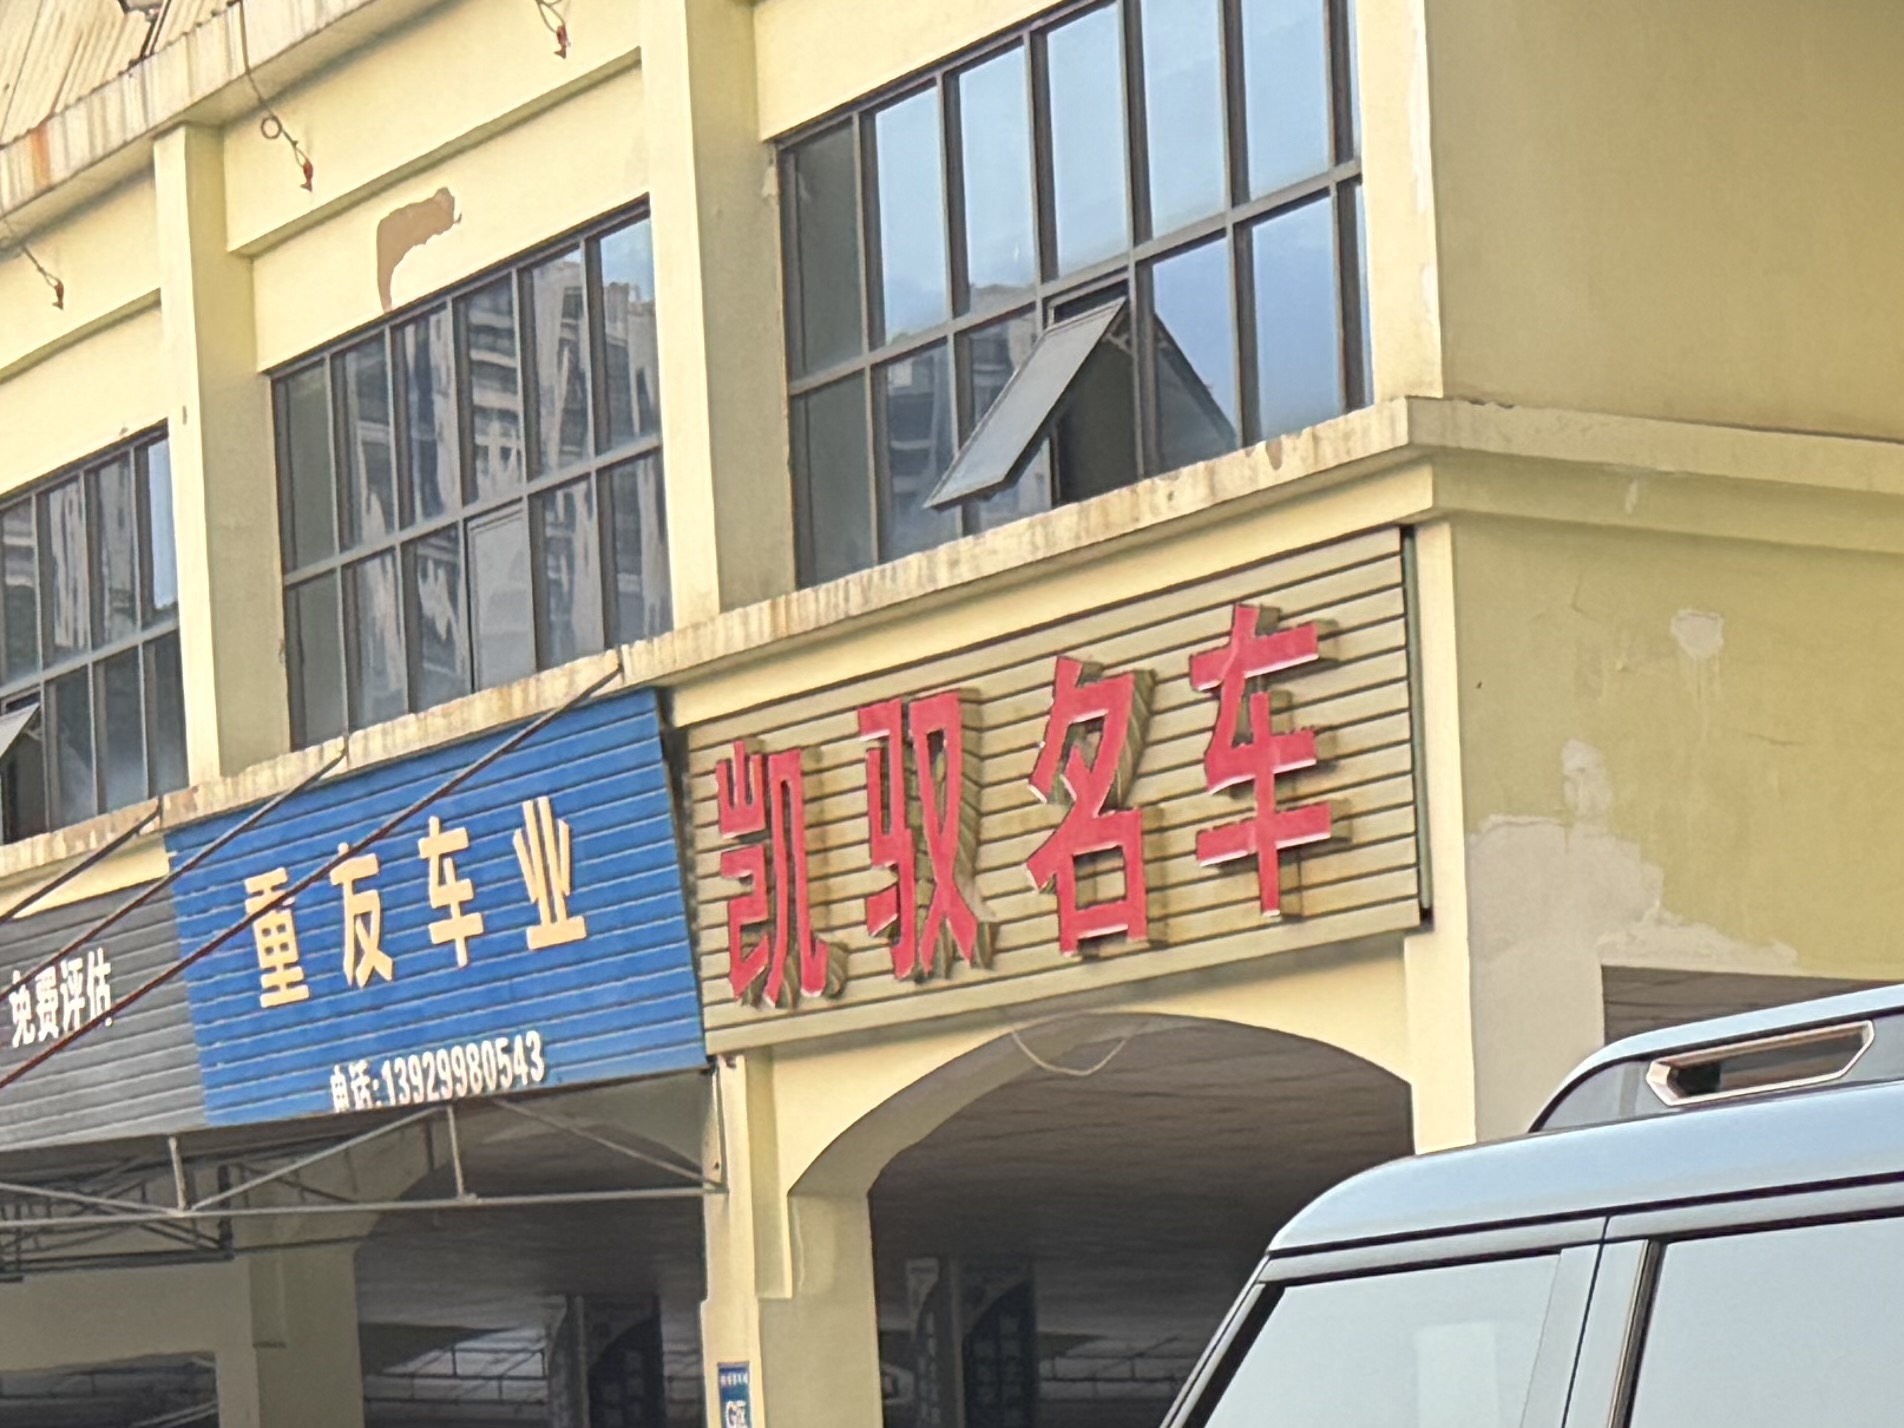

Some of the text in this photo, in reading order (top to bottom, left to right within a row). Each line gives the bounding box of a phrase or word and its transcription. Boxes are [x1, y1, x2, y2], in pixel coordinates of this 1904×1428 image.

[244, 795, 588, 1010] 重友车业
[714, 602, 1333, 1008] 凯驭名车
